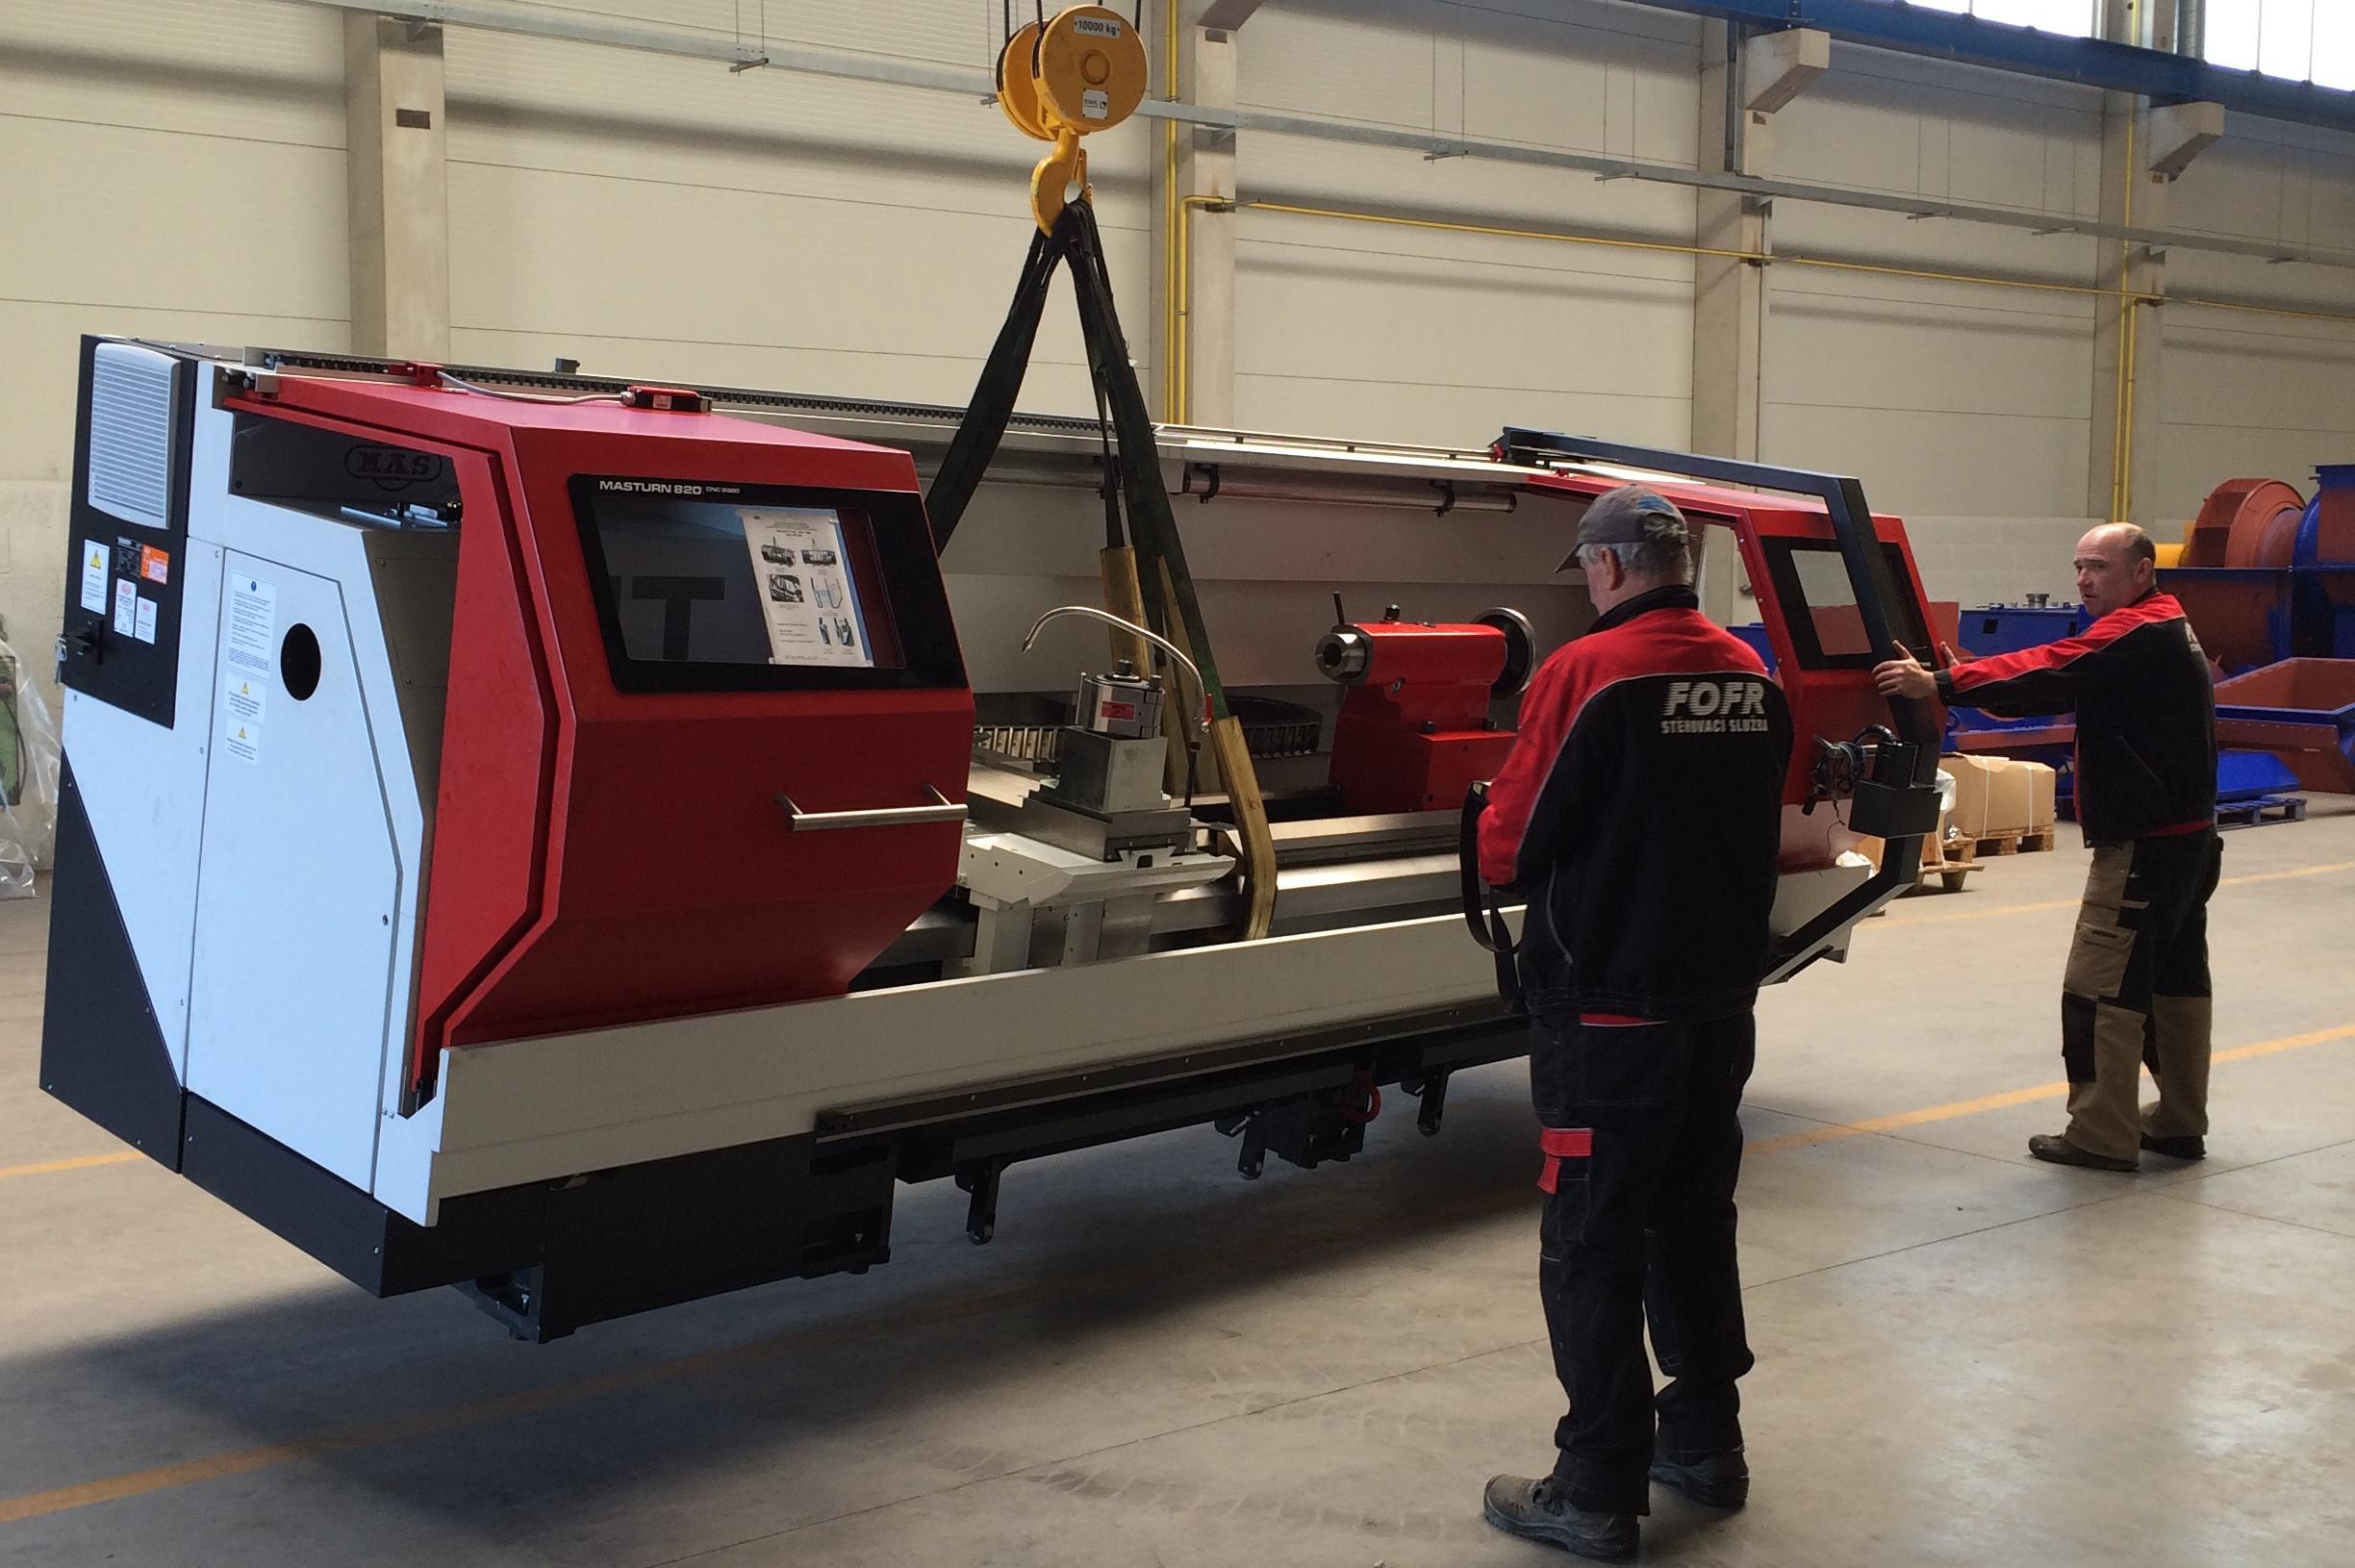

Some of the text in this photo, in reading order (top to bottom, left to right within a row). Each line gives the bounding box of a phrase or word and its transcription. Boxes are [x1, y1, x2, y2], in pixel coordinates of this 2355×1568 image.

[1078, 20, 1116, 37] 10000 kg
[358, 450, 430, 475] MAS
[599, 480, 671, 493] MASTURN
[673, 485, 702, 495] 820
[1662, 682, 1765, 716] FOFR
